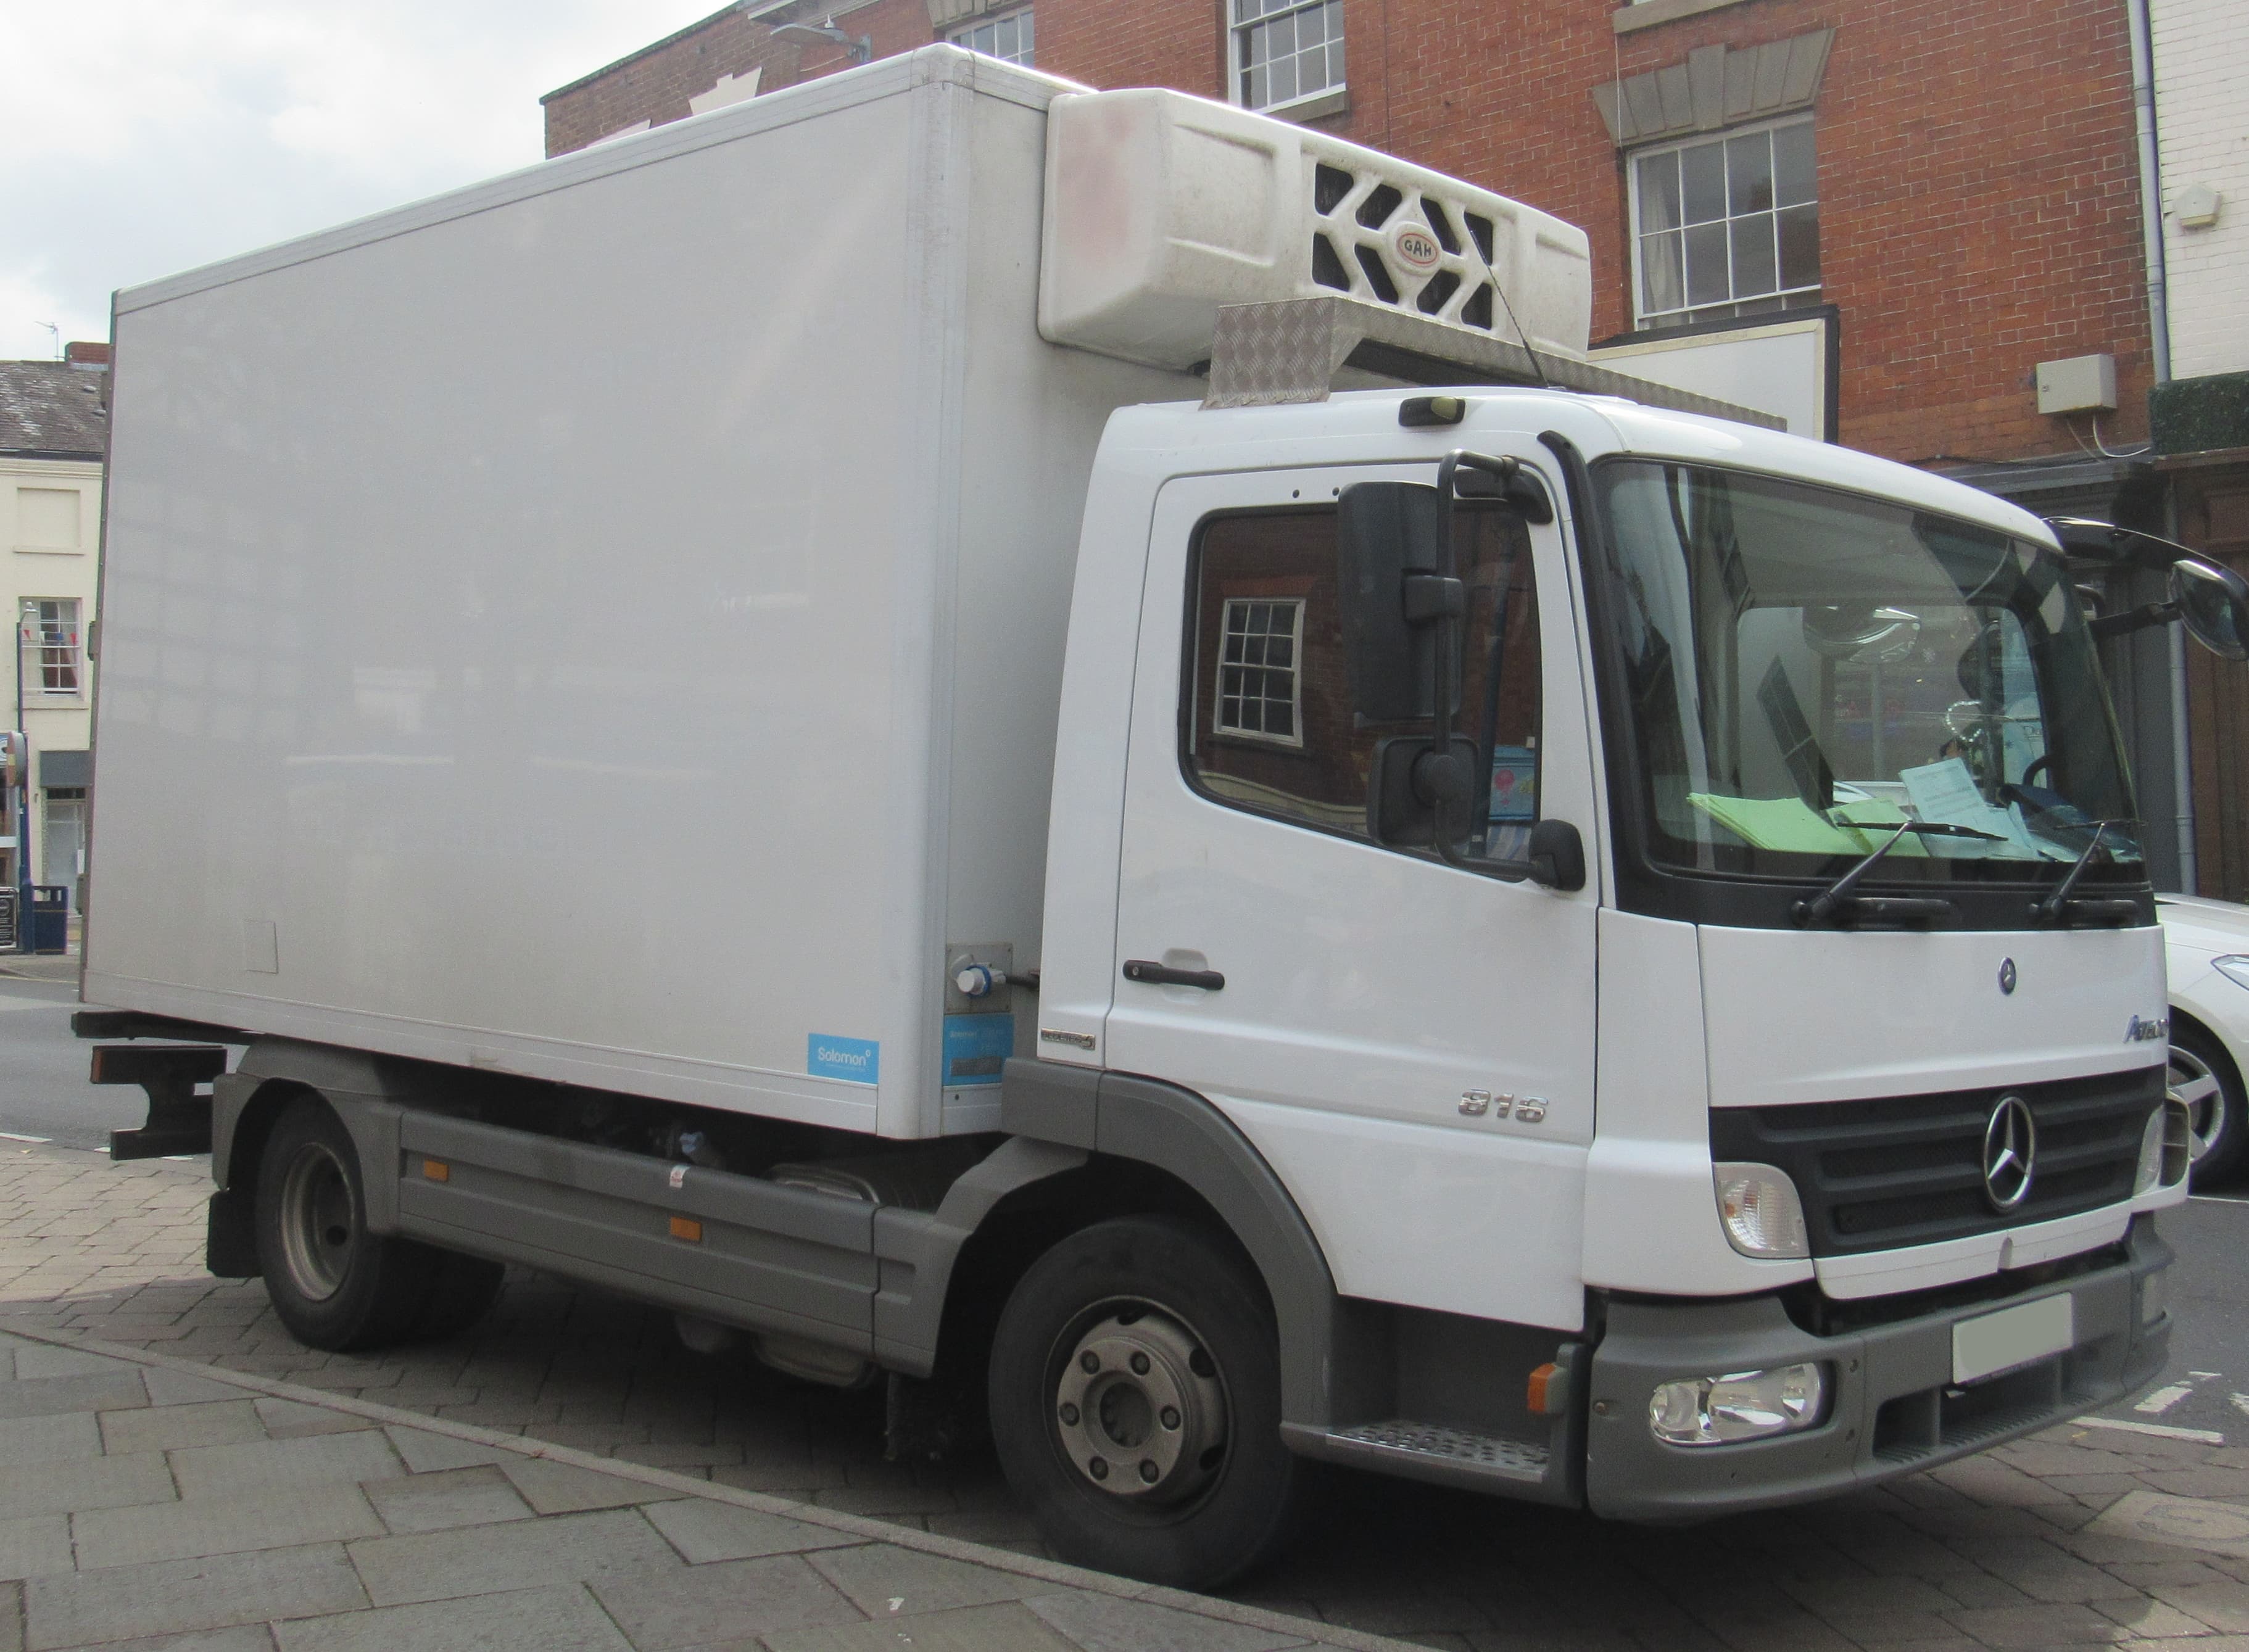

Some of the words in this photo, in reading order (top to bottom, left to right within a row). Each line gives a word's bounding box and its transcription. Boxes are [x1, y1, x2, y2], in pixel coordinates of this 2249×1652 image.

[1404, 239, 1431, 257] GAH
[818, 1046, 867, 1066] Solomon
[1458, 1088, 1549, 1123] 816
